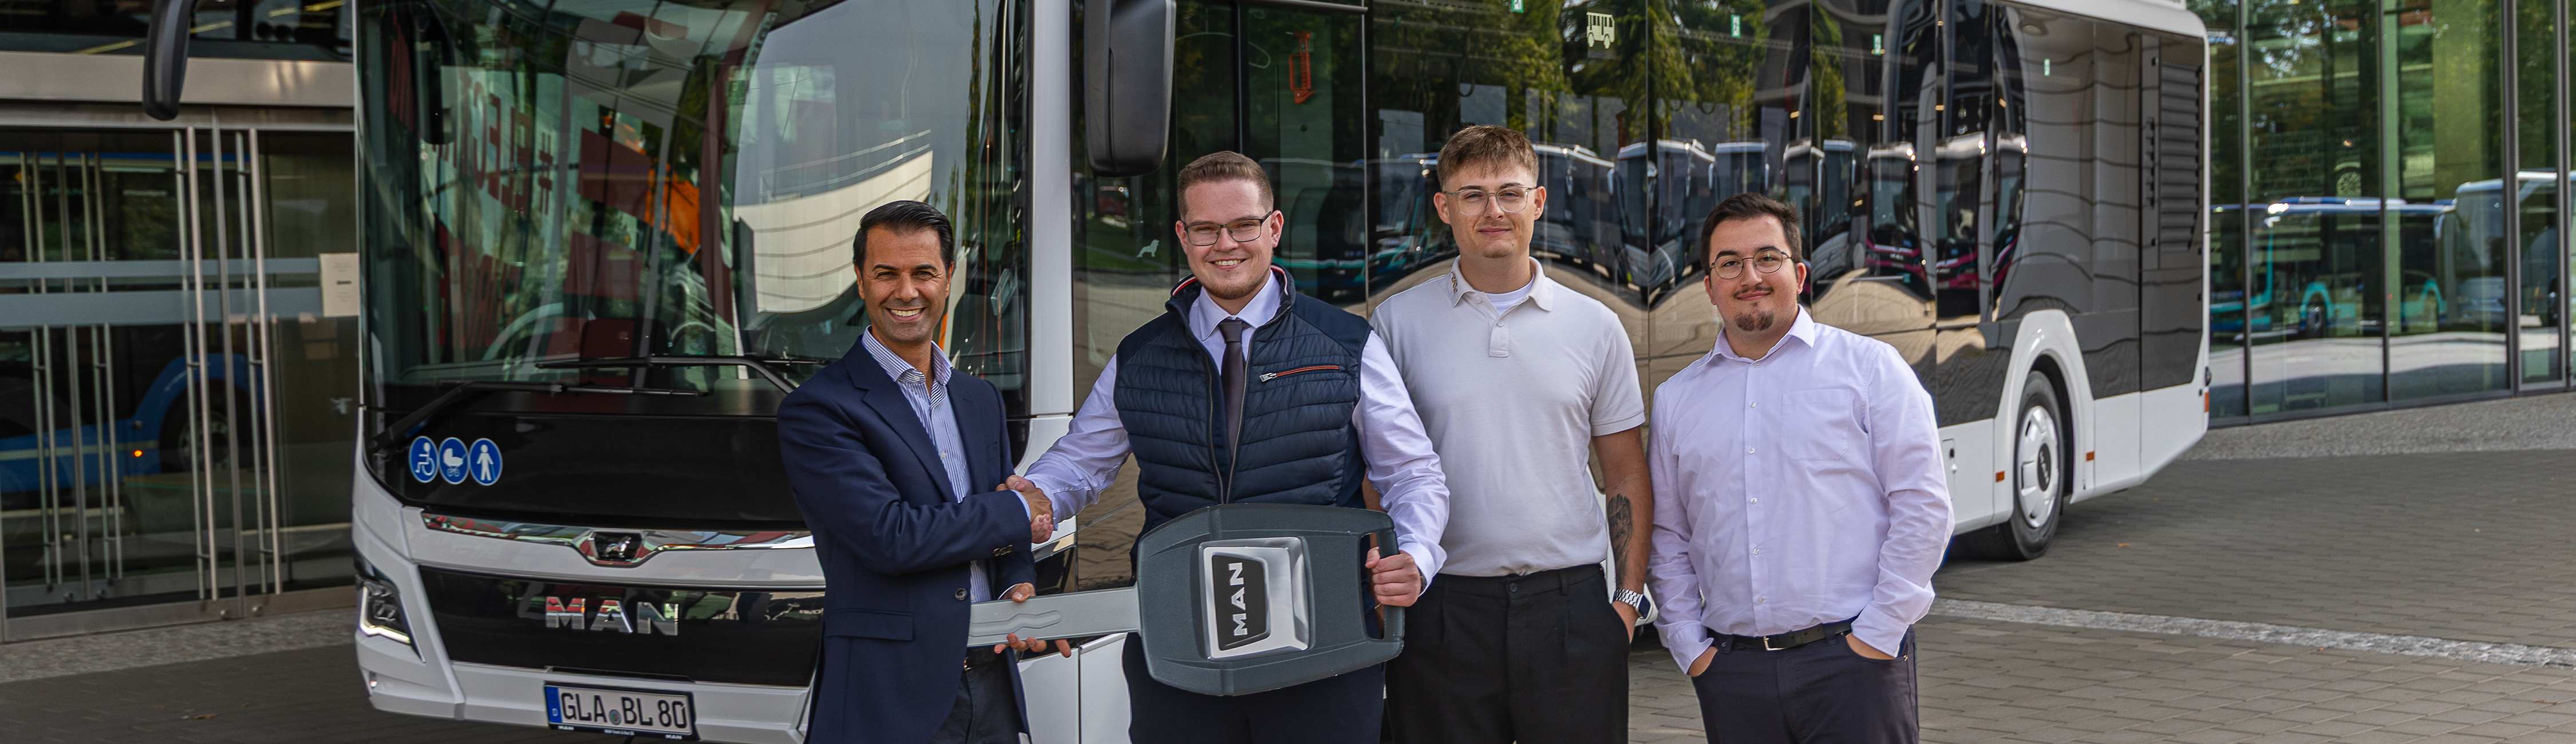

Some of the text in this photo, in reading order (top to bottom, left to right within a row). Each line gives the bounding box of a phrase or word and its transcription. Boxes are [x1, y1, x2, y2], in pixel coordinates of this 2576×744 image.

[546, 596, 678, 635] MAN
[1228, 562, 1248, 636] MAN
[560, 692, 687, 729] GLA BL 80
